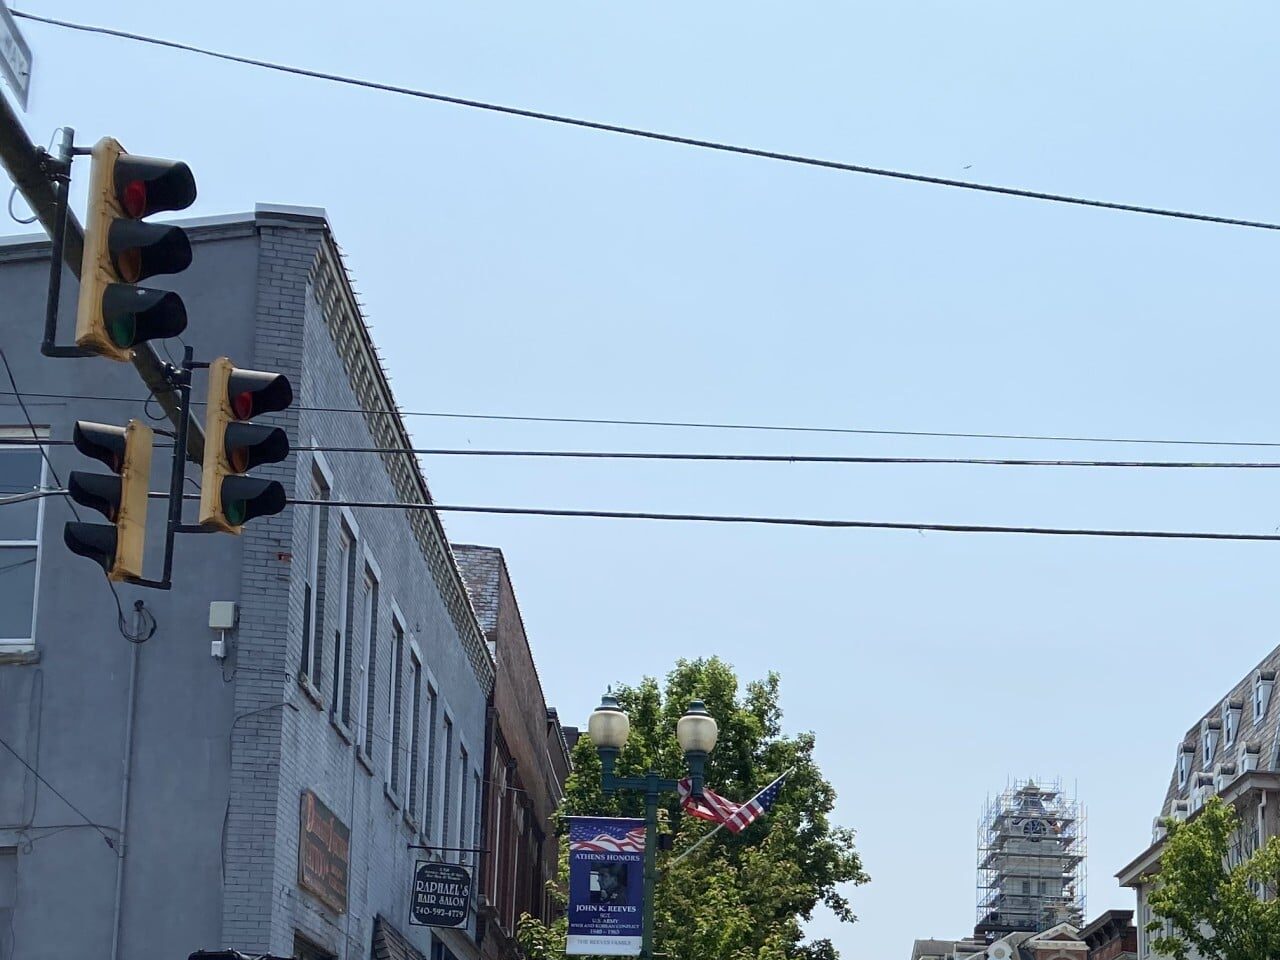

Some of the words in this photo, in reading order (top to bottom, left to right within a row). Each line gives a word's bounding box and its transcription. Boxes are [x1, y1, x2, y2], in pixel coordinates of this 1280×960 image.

[575, 853, 606, 861] ATHENS
[606, 854, 641, 862] HONORS
[416, 880, 469, 897] RAPHAEL'S
[417, 893, 437, 904] HAIR
[438, 895, 465, 907] SALON
[608, 905, 637, 913] REEVES
